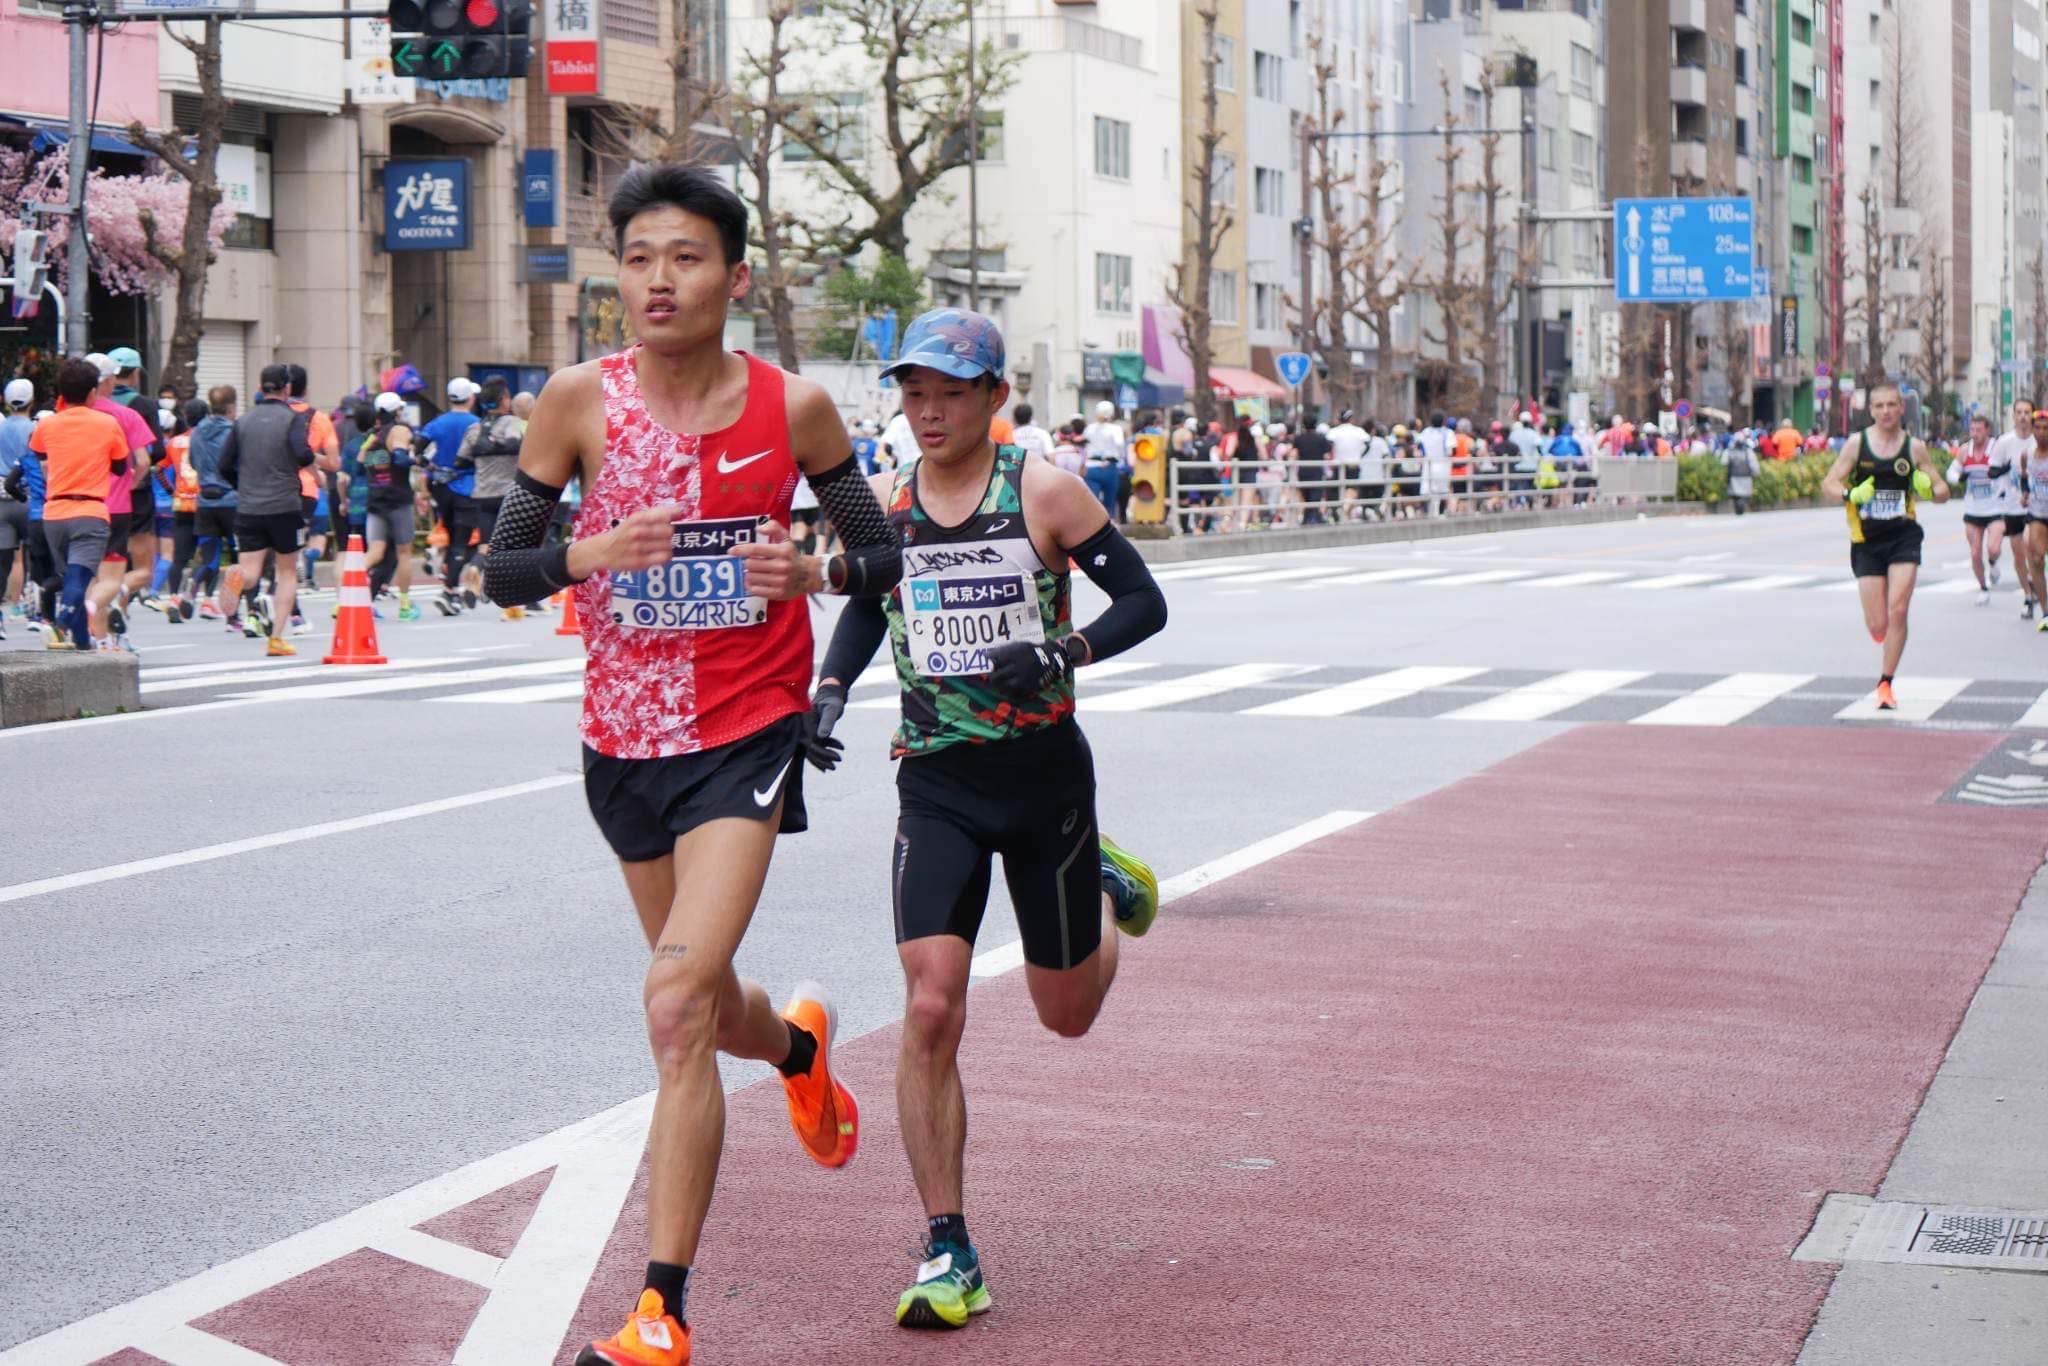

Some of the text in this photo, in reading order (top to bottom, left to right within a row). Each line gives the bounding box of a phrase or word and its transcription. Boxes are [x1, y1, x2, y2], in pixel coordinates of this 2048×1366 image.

[556, 0, 589, 31] 橋
[550, 59, 596, 75] Tabist
[394, 172, 459, 219] 大戸屋
[1651, 204, 1686, 222] 水戸
[398, 227, 455, 238] OOTOYA
[646, 561, 736, 599] 8039
[944, 583, 1018, 603] 東京メトロ
[661, 600, 750, 627] STARTS
[912, 619, 924, 635] C
[933, 611, 1011, 646] 80004
[1015, 614, 1022, 625] 1
